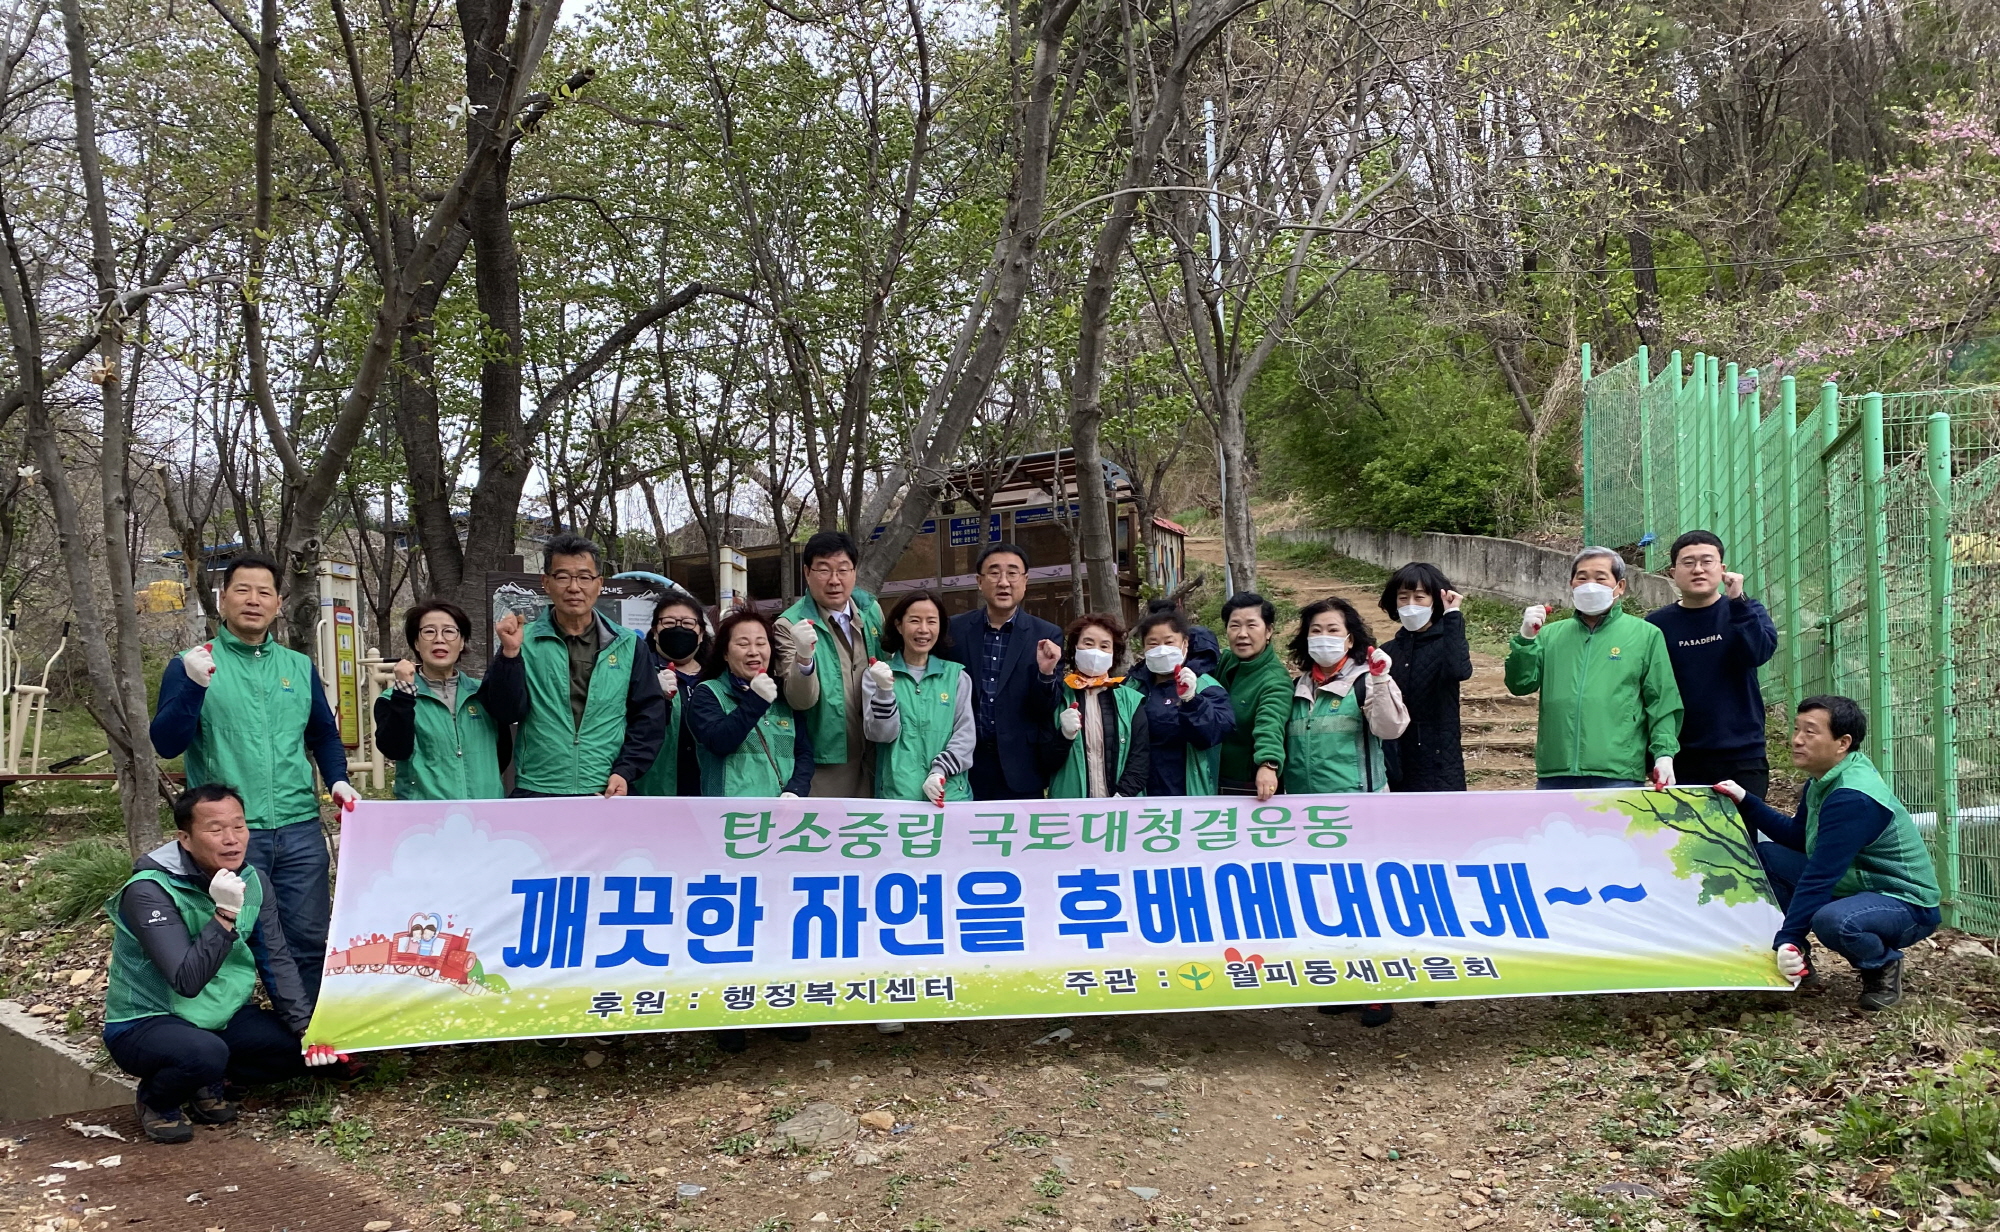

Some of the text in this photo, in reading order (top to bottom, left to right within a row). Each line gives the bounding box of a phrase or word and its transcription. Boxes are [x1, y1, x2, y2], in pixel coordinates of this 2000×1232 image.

[1679, 634, 1722, 647] PASADENA
[720, 805, 1353, 859] 탄소중립 국토대청결운동
[502, 874, 764, 969] 깨끗한
[792, 870, 1026, 960] 자연을
[1065, 968, 1137, 995] 주관
[1225, 956, 1500, 988] 월피동새마을회
[587, 991, 666, 1018] 후원
[723, 976, 954, 1011] 행정복지센터
